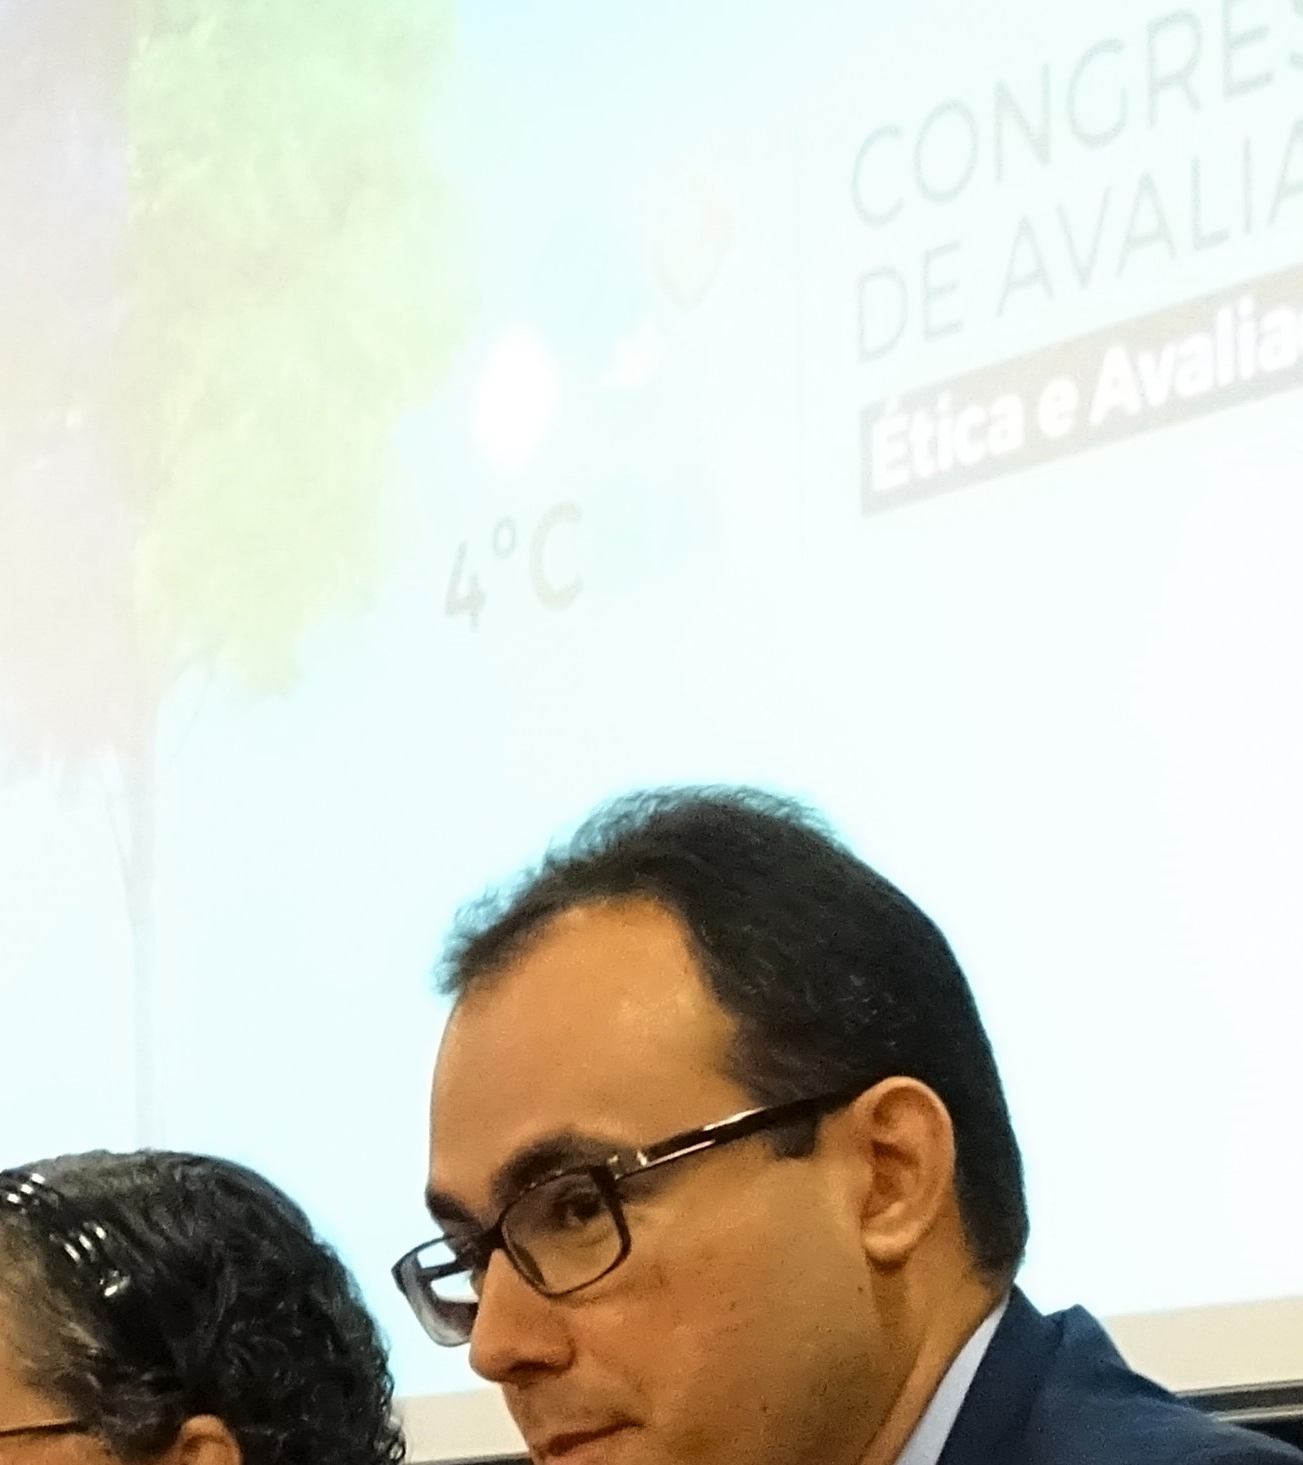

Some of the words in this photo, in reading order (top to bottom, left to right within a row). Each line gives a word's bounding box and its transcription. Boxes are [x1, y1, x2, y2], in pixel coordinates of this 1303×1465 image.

[856, 239, 964, 365] DE
[870, 392, 1025, 494] Ética
[1037, 377, 1079, 440] e
